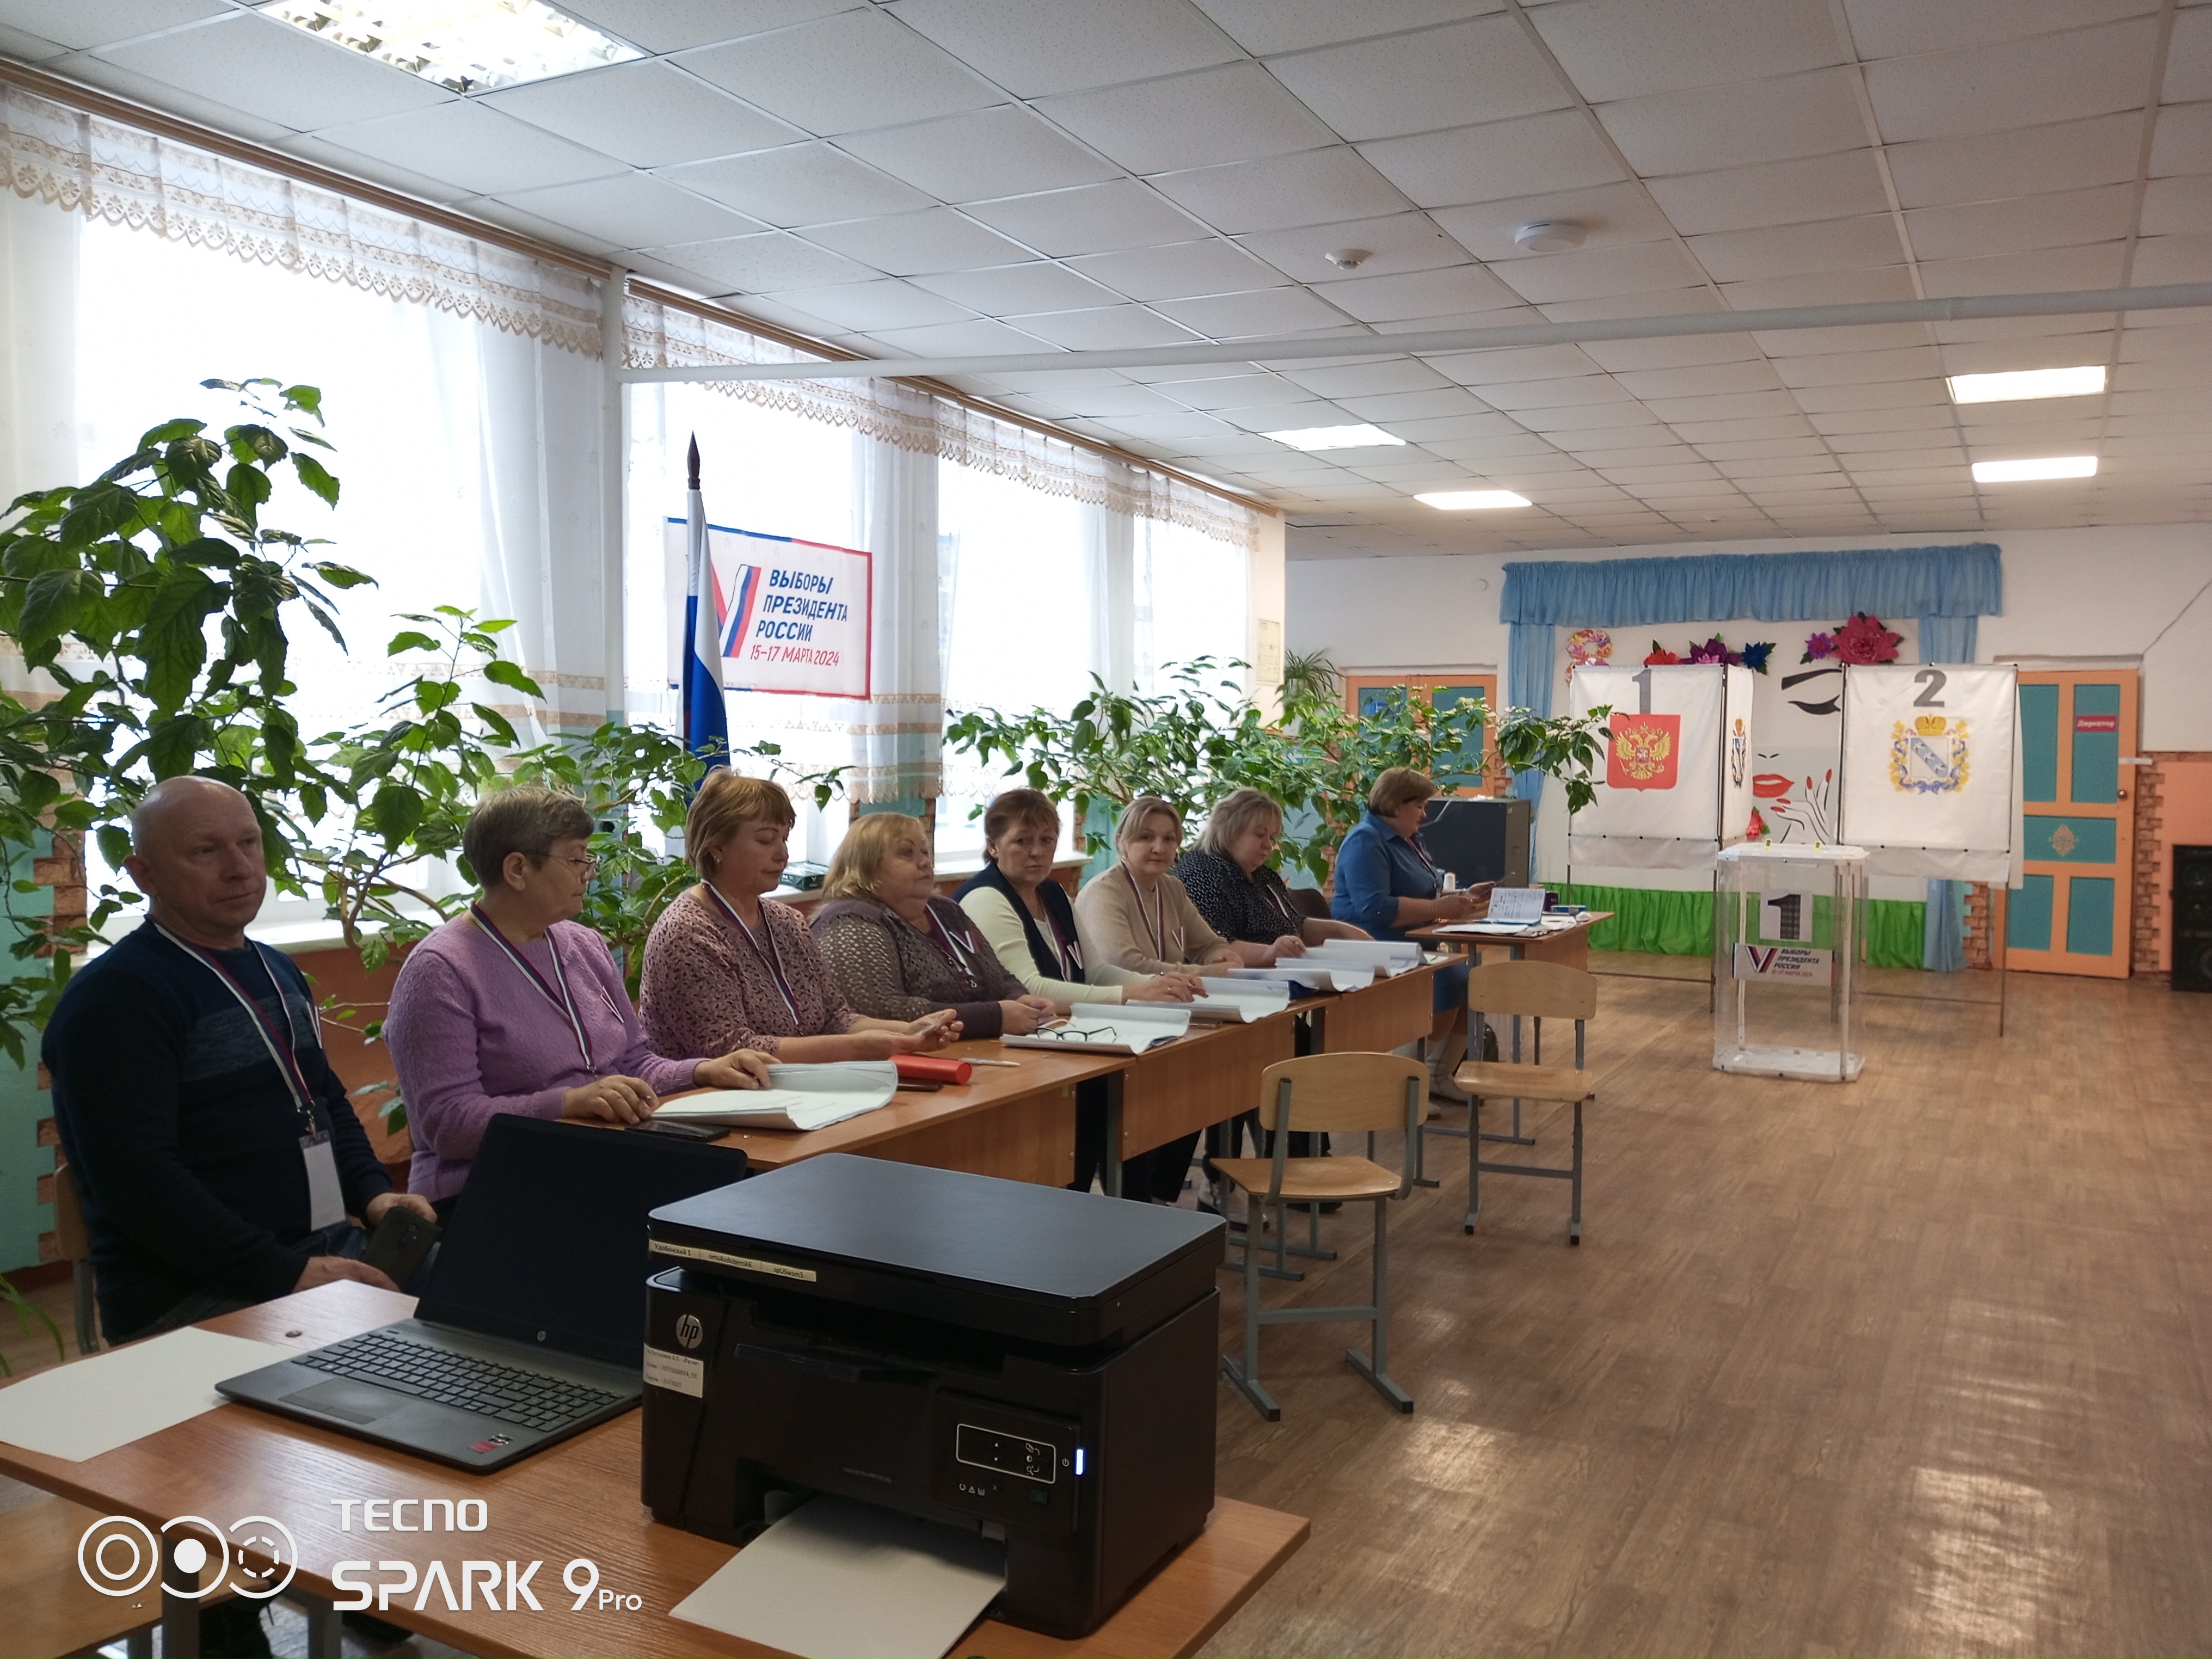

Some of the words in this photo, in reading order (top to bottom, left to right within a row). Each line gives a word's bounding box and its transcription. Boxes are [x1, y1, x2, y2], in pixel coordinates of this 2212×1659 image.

[769, 569, 833, 594] ВЫБОРЫ
[763, 594, 847, 622] ПРЕЗИДЕНТА
[755, 619, 813, 642] РОССИИ
[781, 647, 813, 664] МАРТА
[813, 650, 839, 667] 2024
[1632, 668, 1652, 714] 1
[1913, 669, 1947, 707] 2
[1767, 894, 1802, 940] 1
[1777, 955, 1820, 963] ПРЕЗИДЕНТА
[679, 1314, 699, 1348] hp
